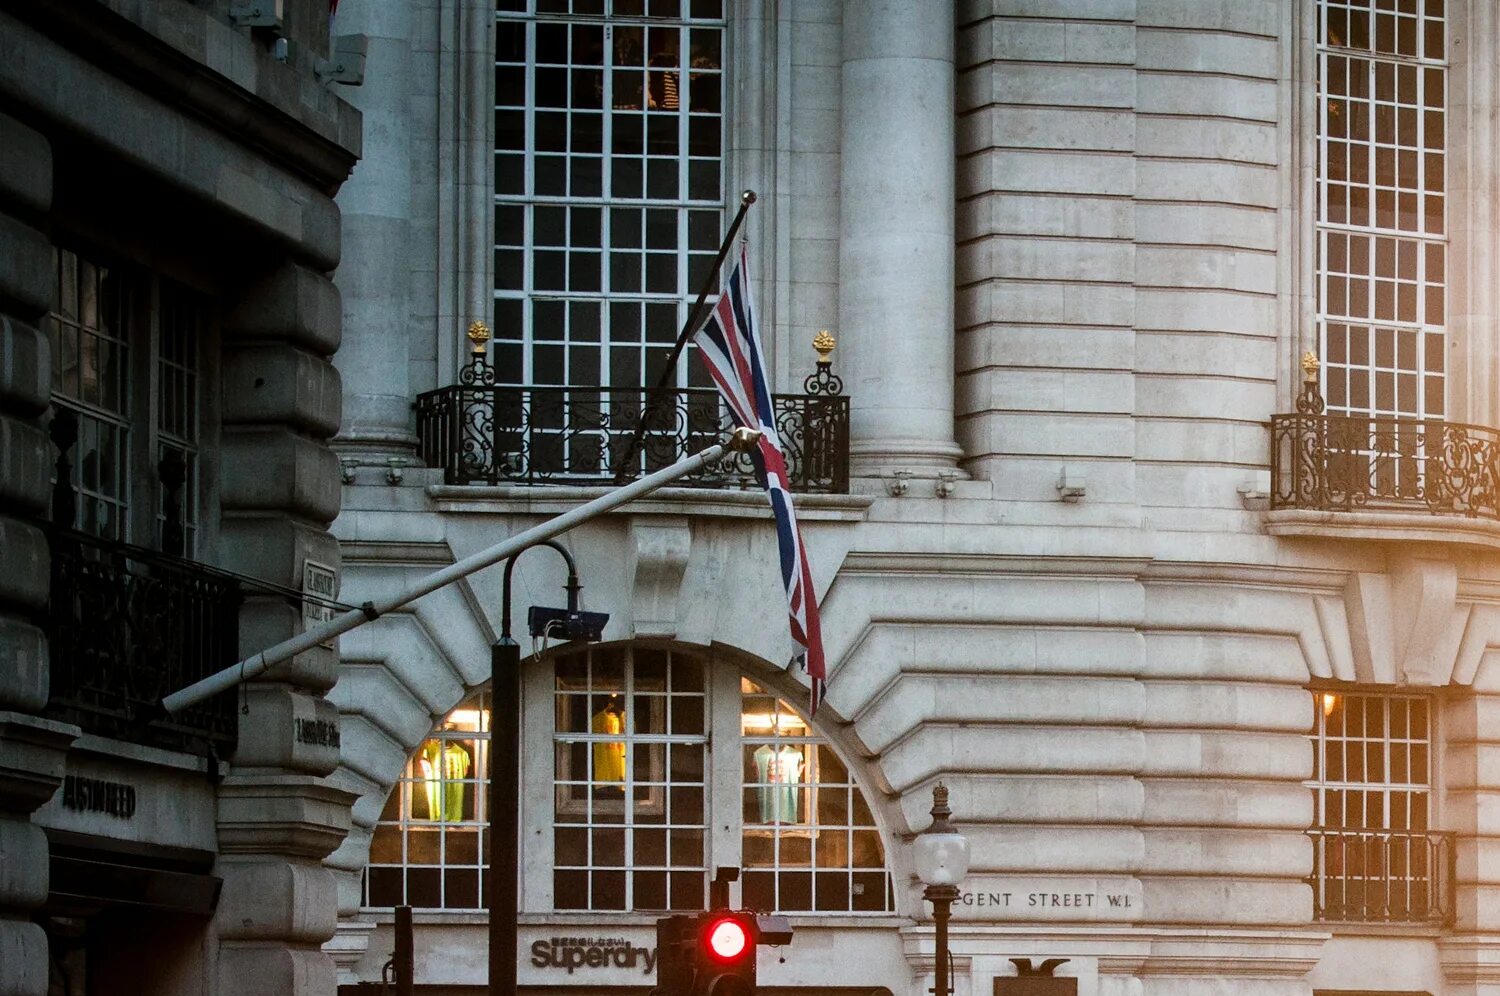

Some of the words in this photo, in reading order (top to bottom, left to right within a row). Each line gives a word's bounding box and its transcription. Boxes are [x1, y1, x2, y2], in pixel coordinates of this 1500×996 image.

[952, 892, 1013, 907] GENT
[1028, 893, 1095, 907] STREET
[531, 940, 658, 974] Superdry
